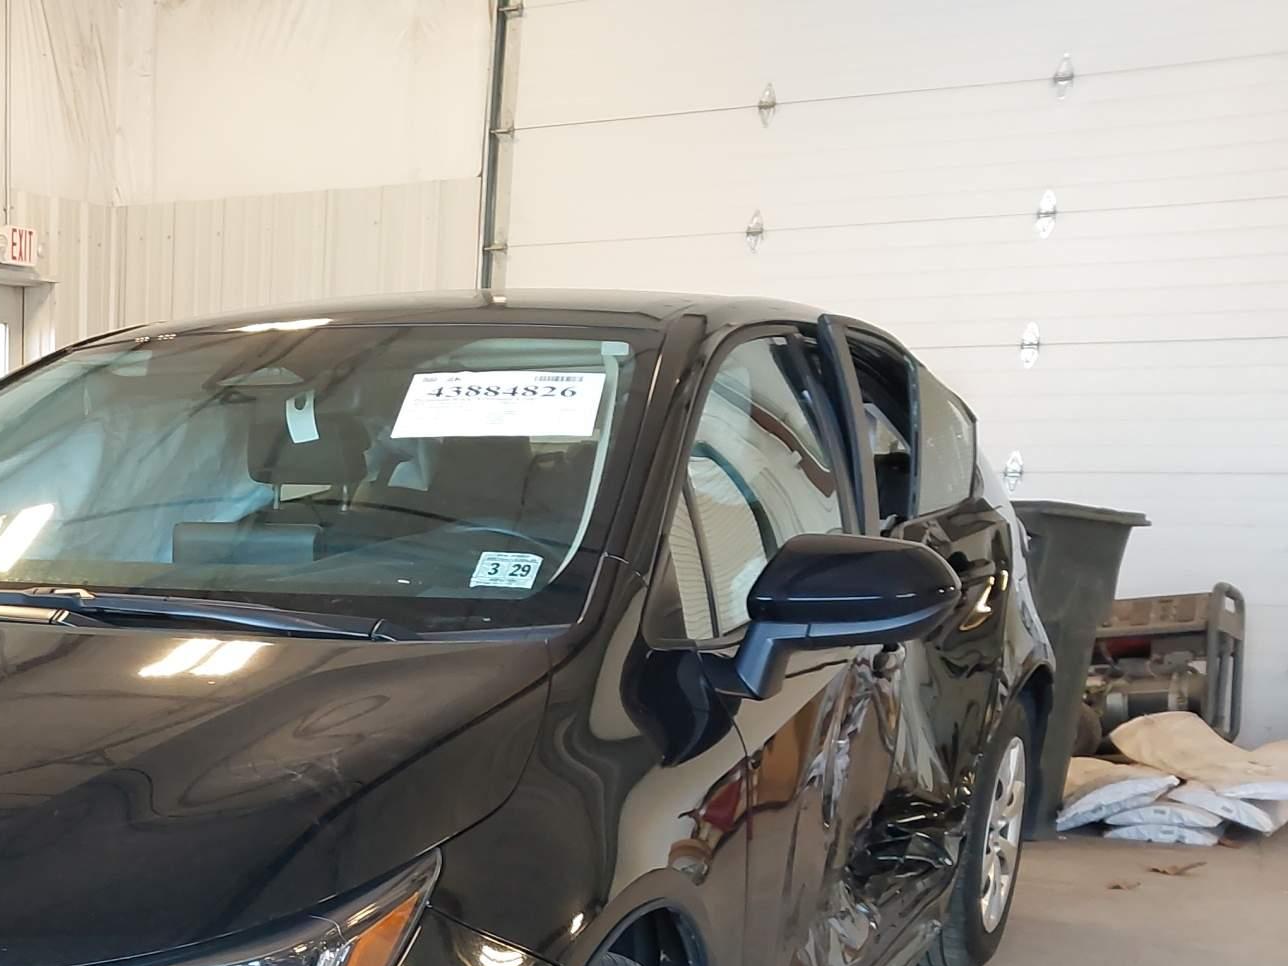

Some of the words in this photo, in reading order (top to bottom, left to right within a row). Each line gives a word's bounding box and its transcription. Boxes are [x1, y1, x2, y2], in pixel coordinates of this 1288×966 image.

[11, 228, 33, 262] EXIT
[427, 384, 577, 398] 43884826
[487, 562, 500, 576] 3
[508, 563, 532, 577] 29
